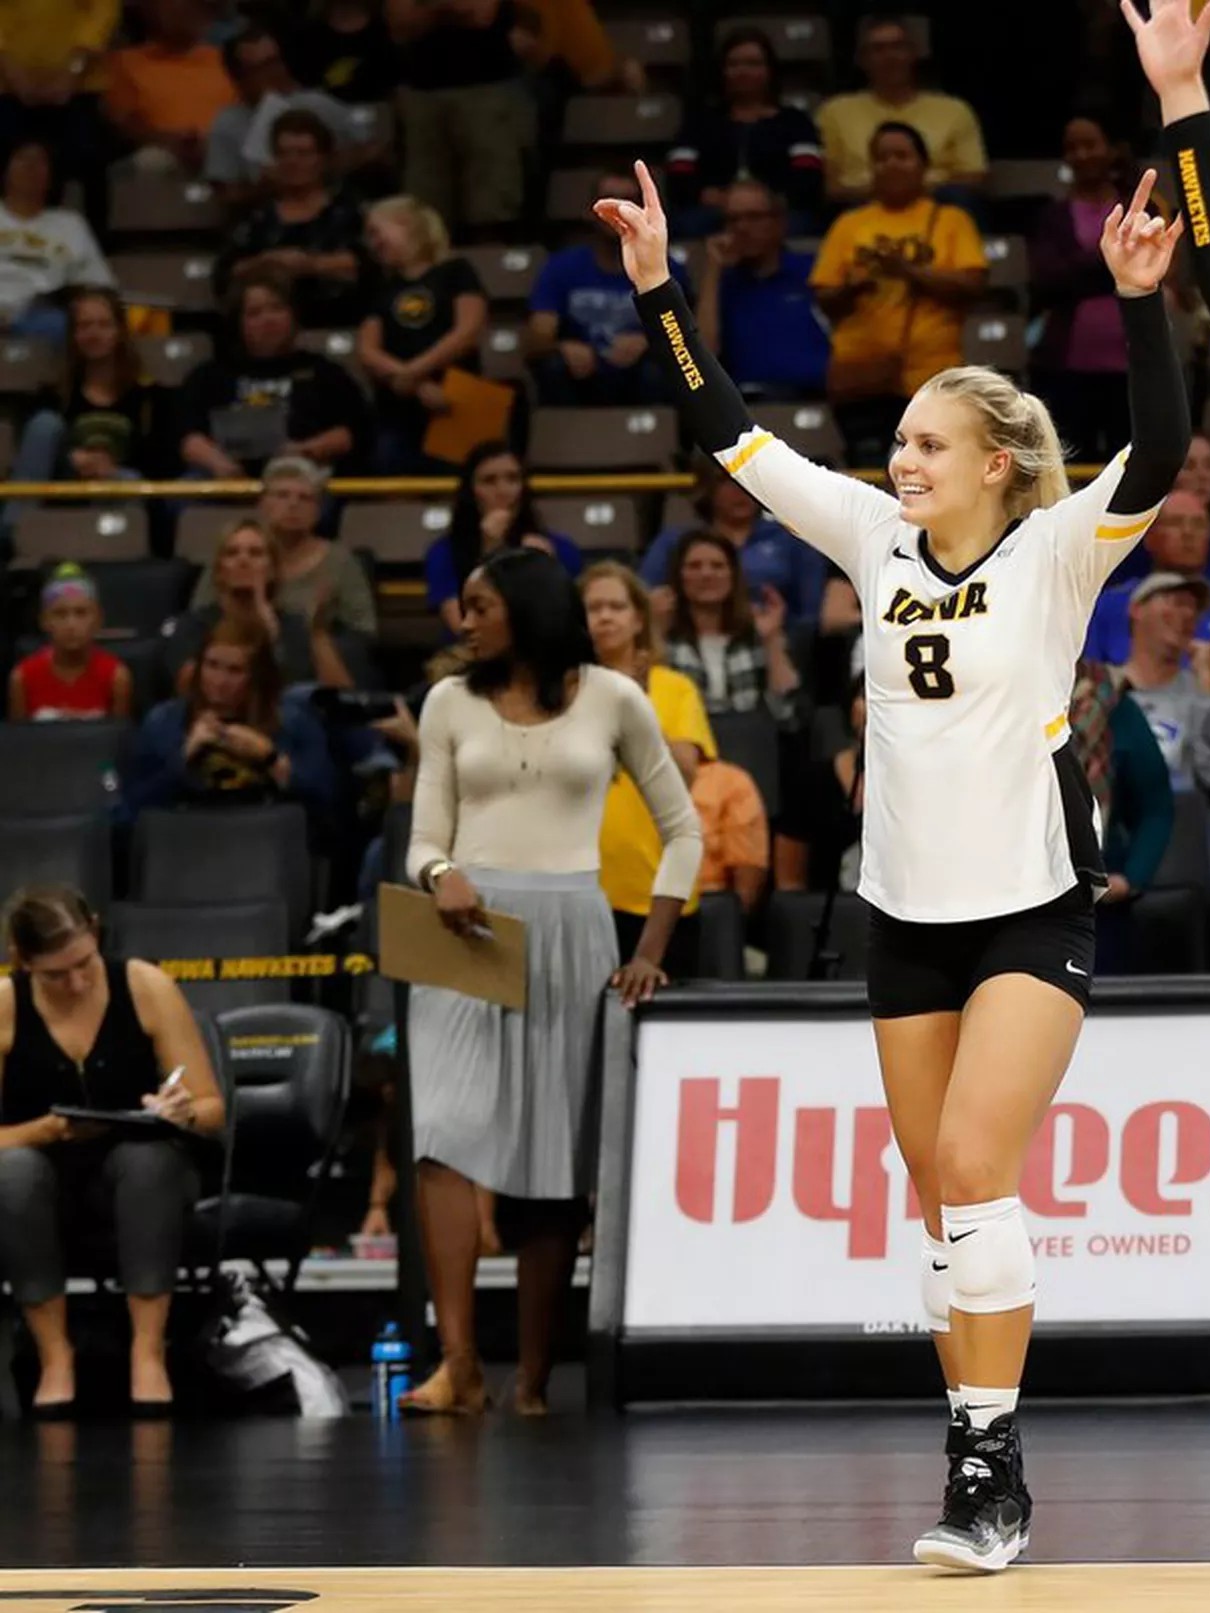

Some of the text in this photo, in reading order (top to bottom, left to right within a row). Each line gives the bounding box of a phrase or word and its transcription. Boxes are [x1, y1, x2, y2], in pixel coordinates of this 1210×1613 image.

[660, 309, 705, 391] HAWKEYES
[903, 633, 956, 701] 8
[220, 955, 336, 978] HAWKEYES
[1086, 1233, 1192, 1257] OWNED
